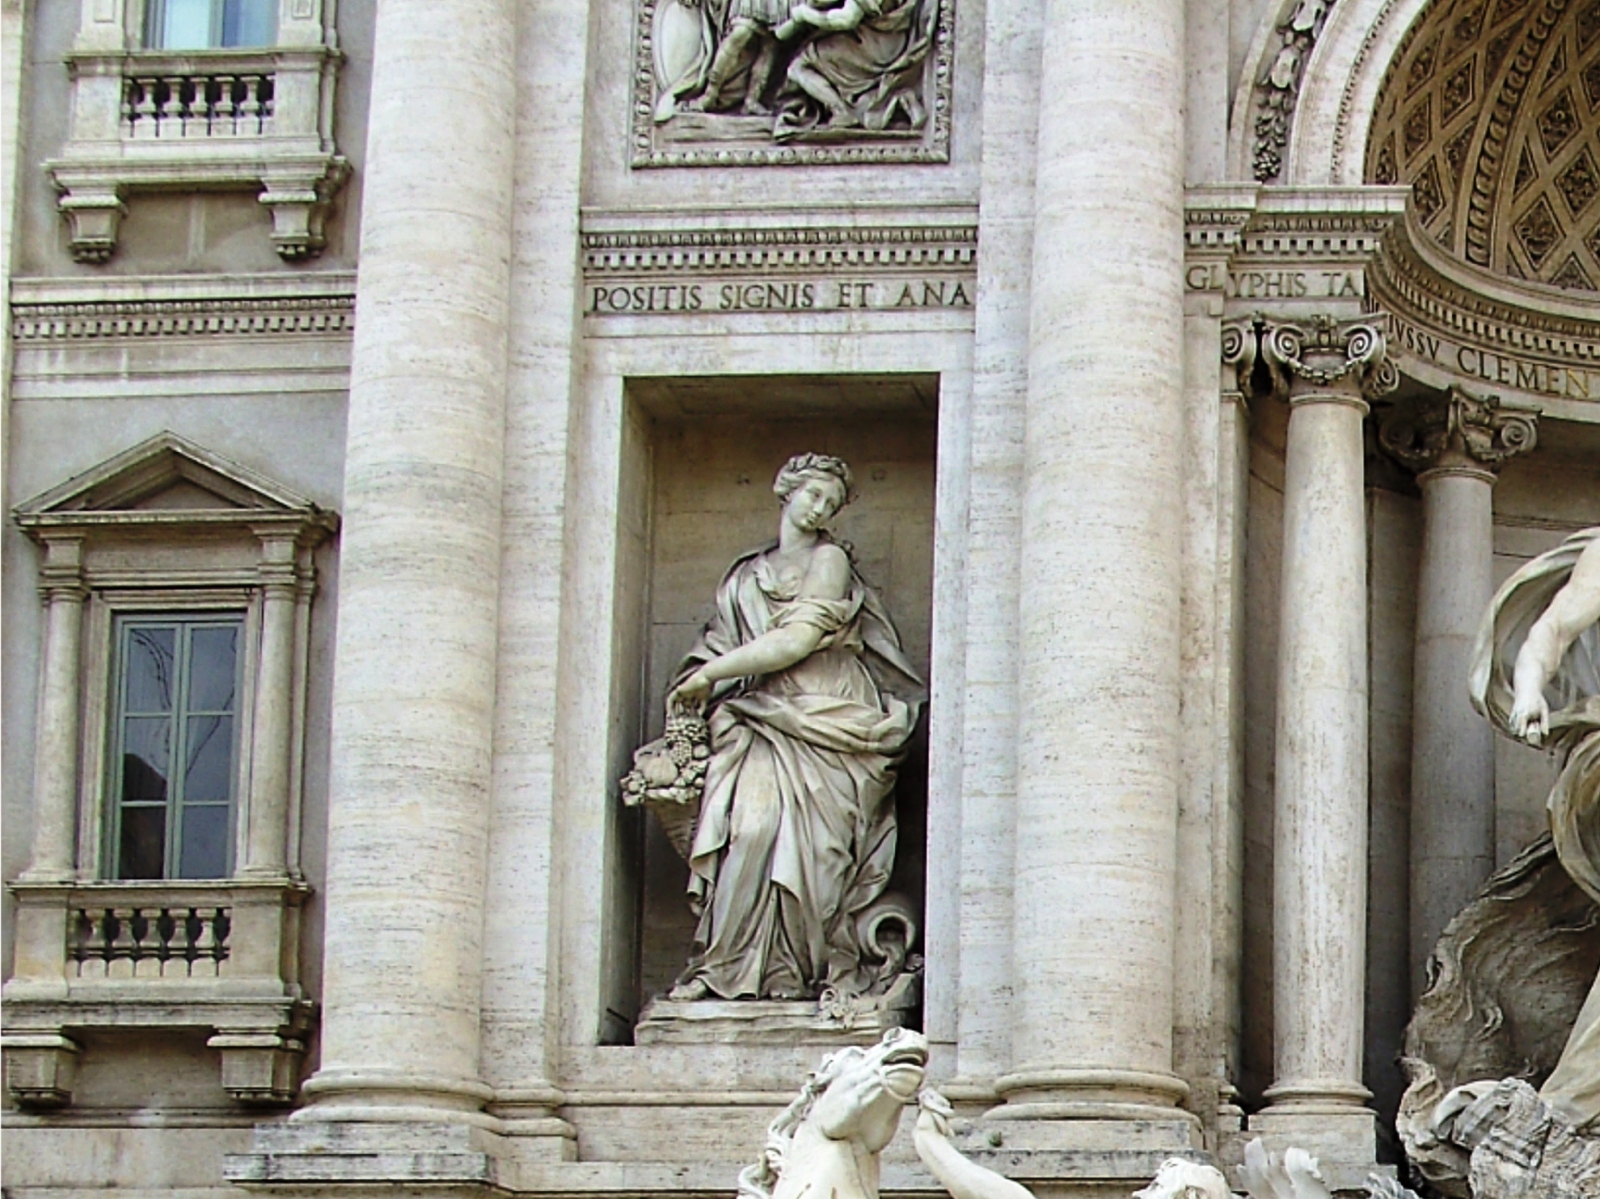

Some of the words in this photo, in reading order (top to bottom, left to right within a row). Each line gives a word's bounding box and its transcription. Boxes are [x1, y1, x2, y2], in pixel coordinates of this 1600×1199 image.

[592, 285, 702, 312] POSITIS
[719, 283, 814, 310] SIGNIS
[837, 282, 874, 308] ET
[896, 281, 971, 306] ANA
[1388, 314, 1440, 361] IVSSV
